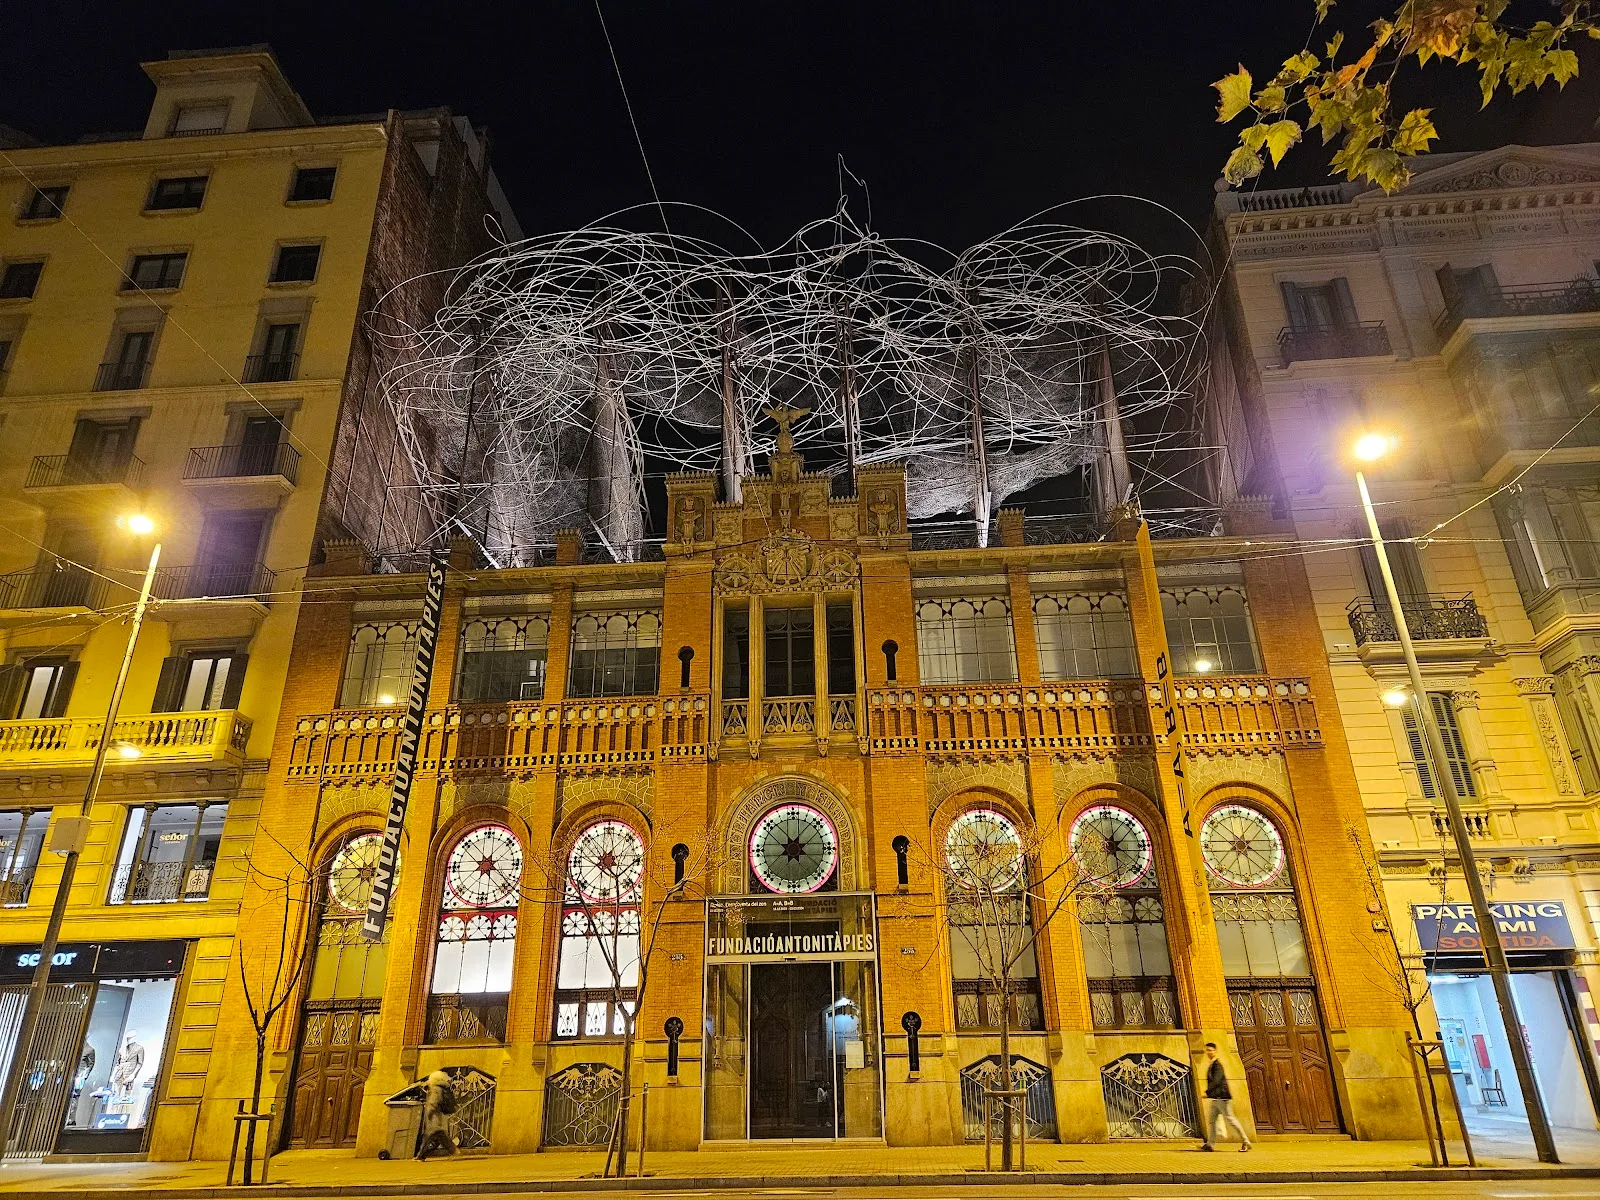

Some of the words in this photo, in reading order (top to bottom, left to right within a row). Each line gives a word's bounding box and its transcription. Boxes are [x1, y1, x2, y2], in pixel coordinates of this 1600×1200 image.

[159, 833, 188, 841] señor
[1416, 903, 1563, 920] PARKING
[1439, 935, 1556, 949] SOTIDA
[17, 952, 78, 967] seor
